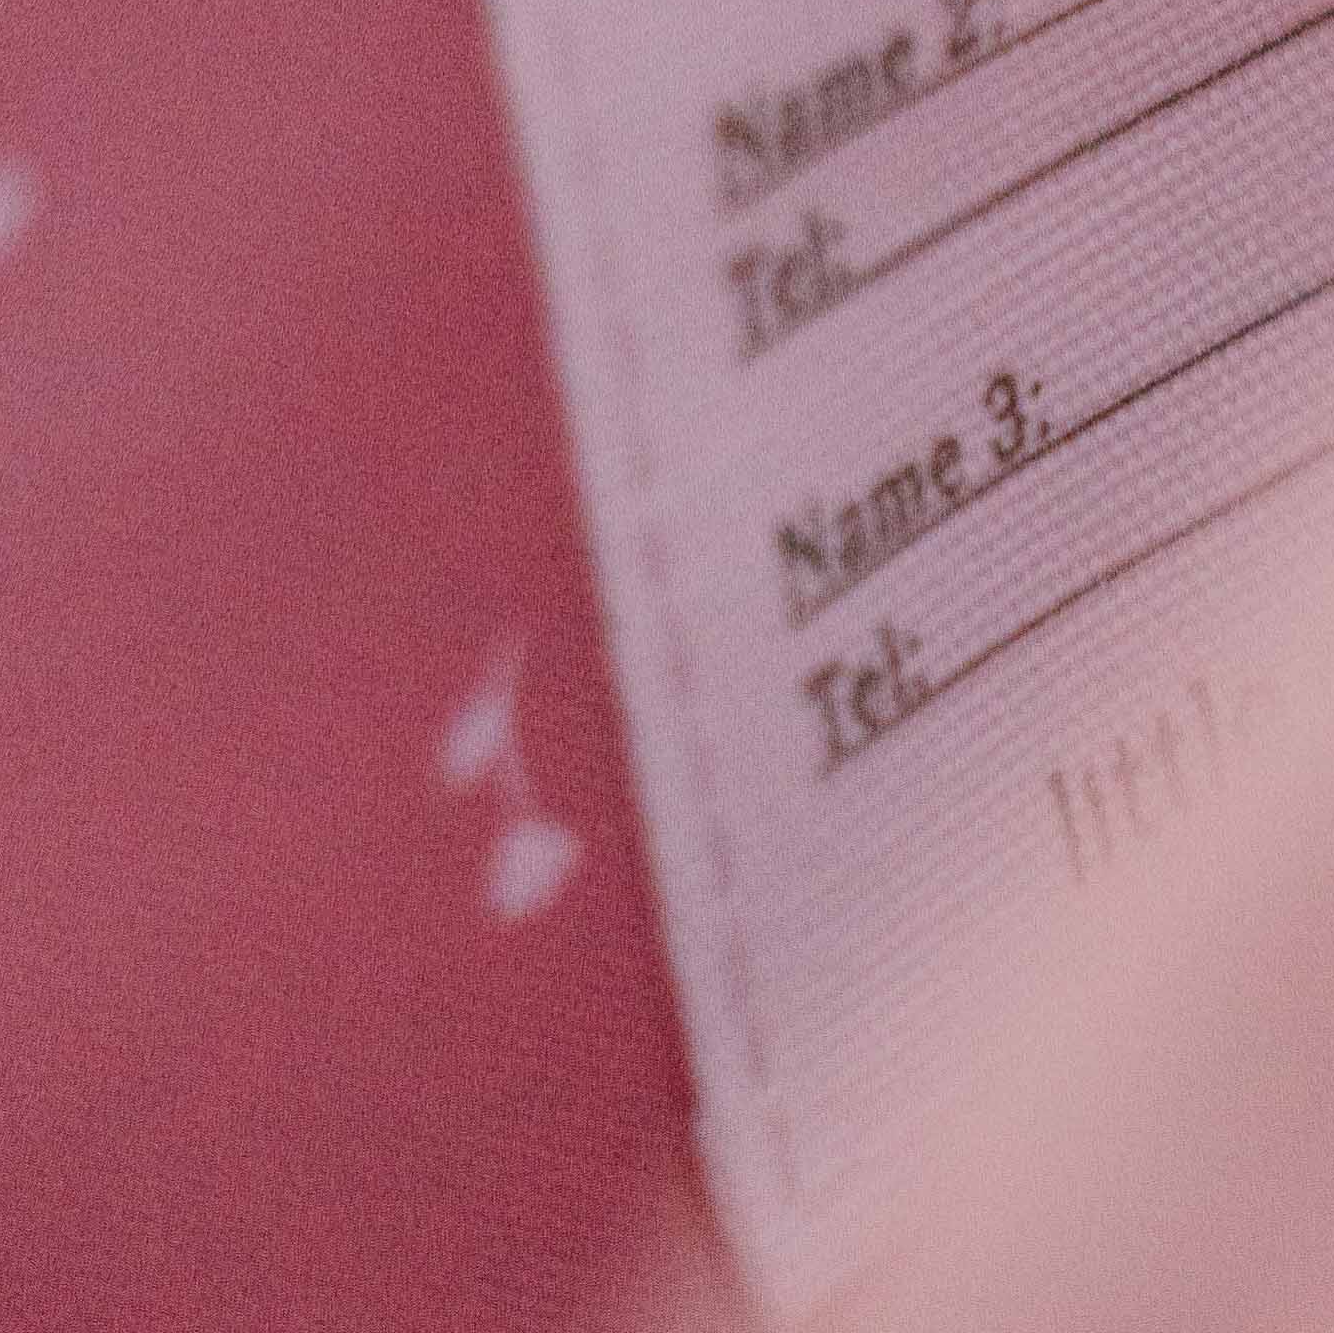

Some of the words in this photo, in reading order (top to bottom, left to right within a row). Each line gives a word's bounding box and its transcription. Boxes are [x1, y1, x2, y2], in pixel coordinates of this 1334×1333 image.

[715, 25, 916, 213] Name
[774, 436, 966, 631] Name
[984, 371, 1049, 463] 3:
[800, 628, 927, 779] Tel:
